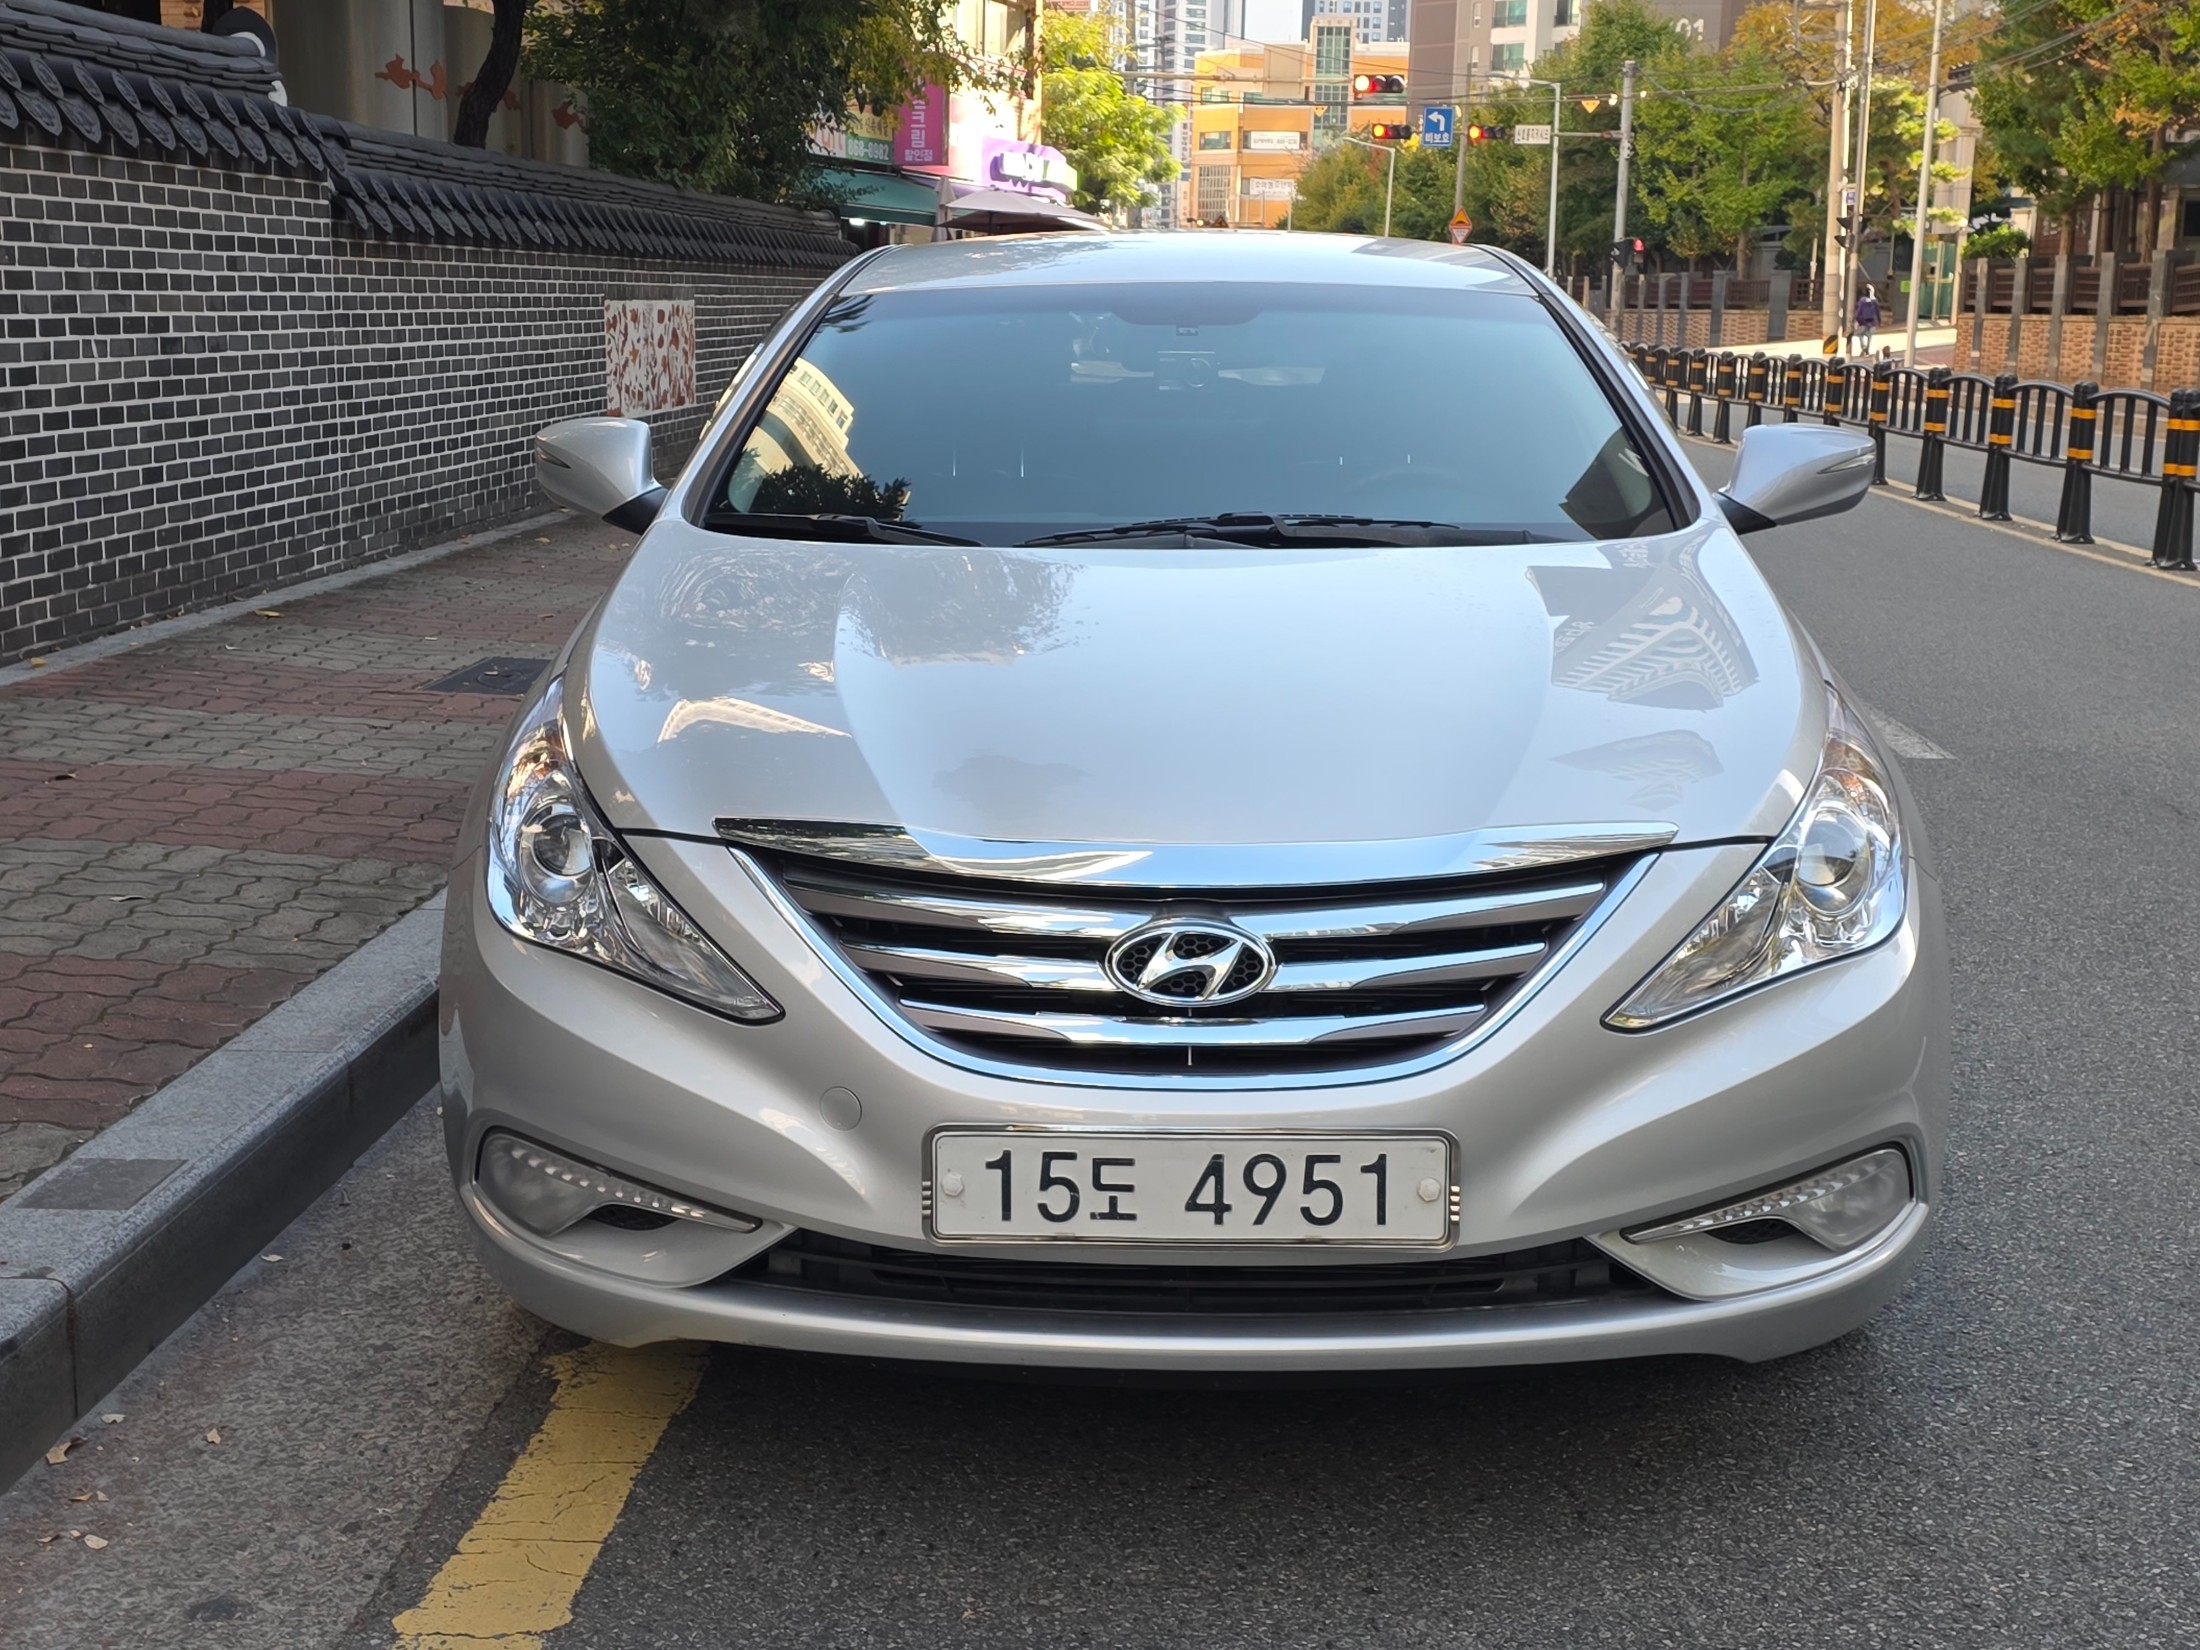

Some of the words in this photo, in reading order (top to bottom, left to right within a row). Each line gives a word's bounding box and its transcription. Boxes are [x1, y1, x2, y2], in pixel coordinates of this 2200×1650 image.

[1670, 18, 1704, 41] 01
[1425, 132, 1450, 143] 비보호
[904, 149, 933, 162] 할인점
[985, 1149, 1137, 1223] 15도
[1185, 1153, 1387, 1226] 4951
